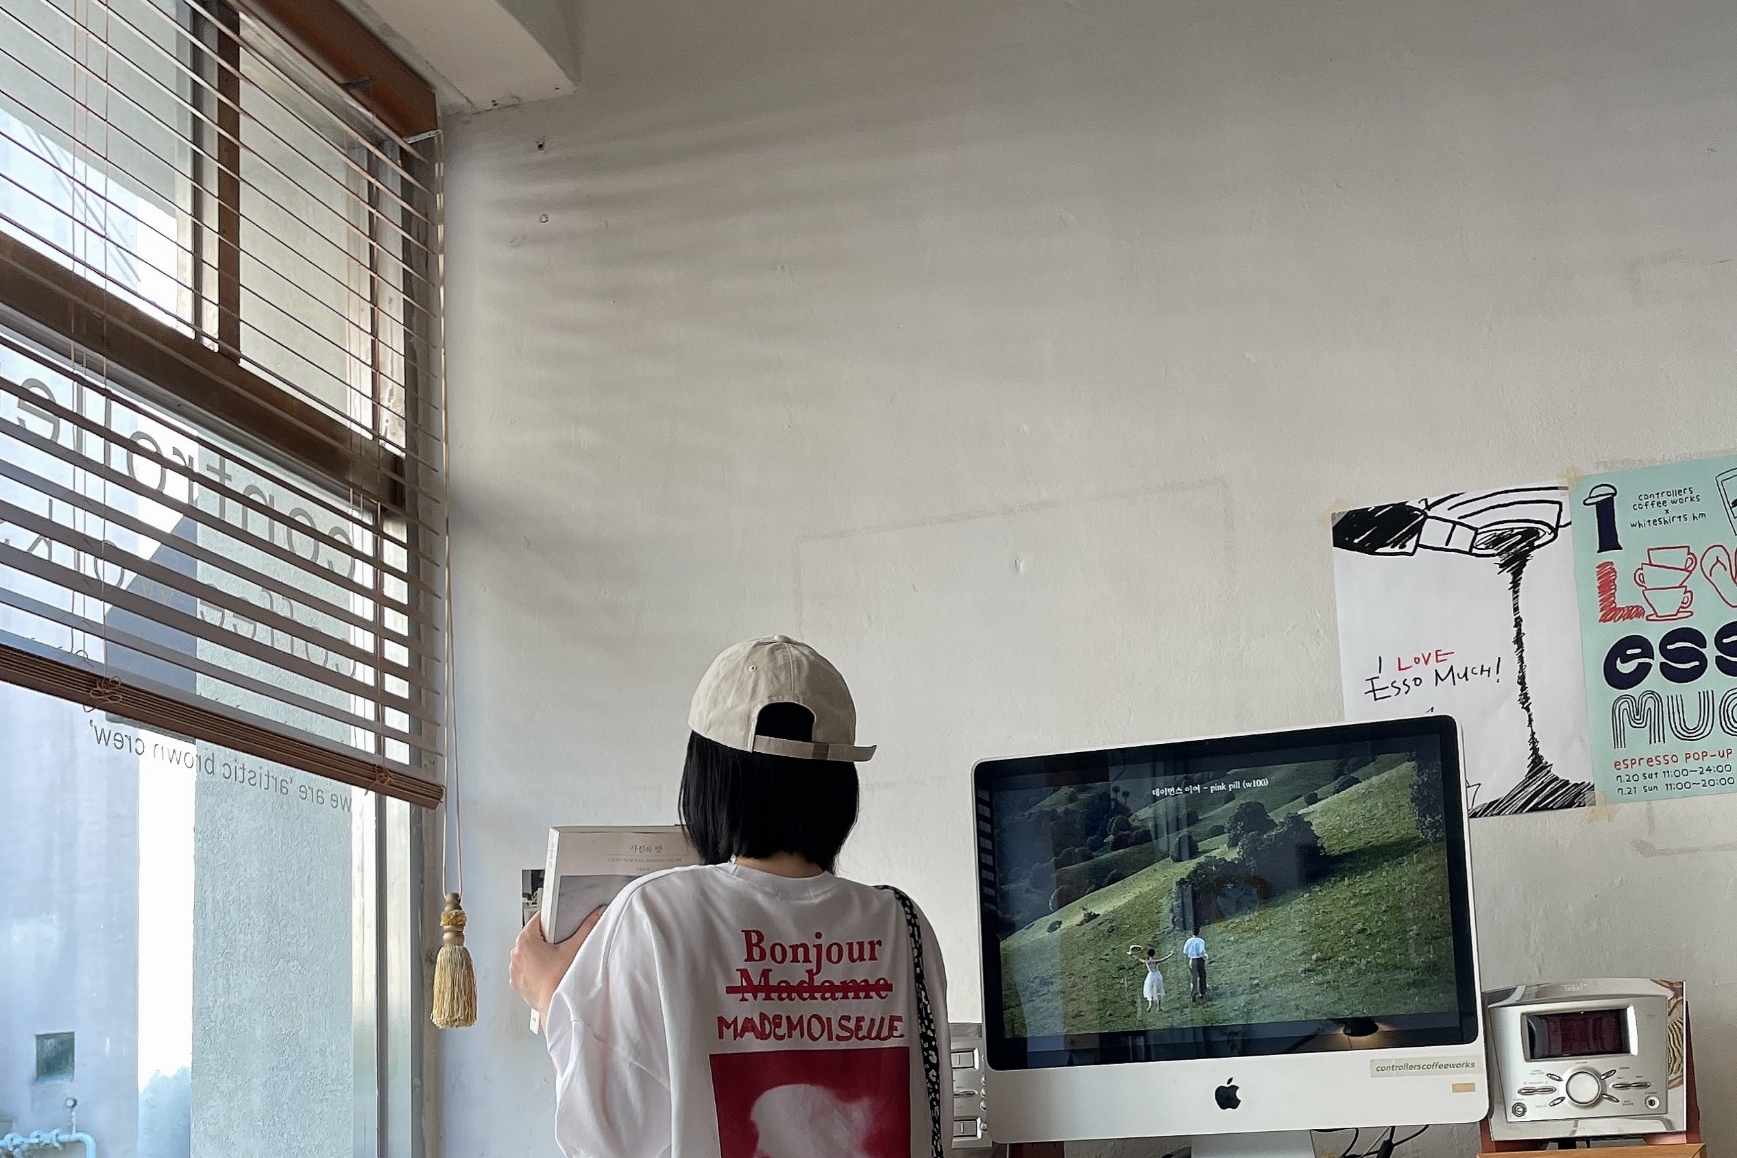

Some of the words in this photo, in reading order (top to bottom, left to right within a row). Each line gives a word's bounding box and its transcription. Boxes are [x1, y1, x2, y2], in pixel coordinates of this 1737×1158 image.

[1632, 499, 1668, 511] coffee
[1671, 494, 1701, 505] works
[1638, 486, 1694, 502] controllers
[1630, 514, 1688, 529] whiteshirts
[1692, 512, 1707, 522] hm
[1378, 655, 1382, 674] I
[1397, 649, 1455, 672] LOVE
[1364, 675, 1423, 701] ESSO
[1613, 754, 1679, 771] espresso
[1616, 773, 1640, 783] 7.20
[1210, 782, 1226, 794] pink
[1228, 781, 1241, 792] pill
[1617, 786, 1637, 796] 7.21
[741, 929, 882, 976] Bonjour
[730, 968, 892, 1003] Madame
[716, 1011, 905, 1042] MADEMOISELLE
